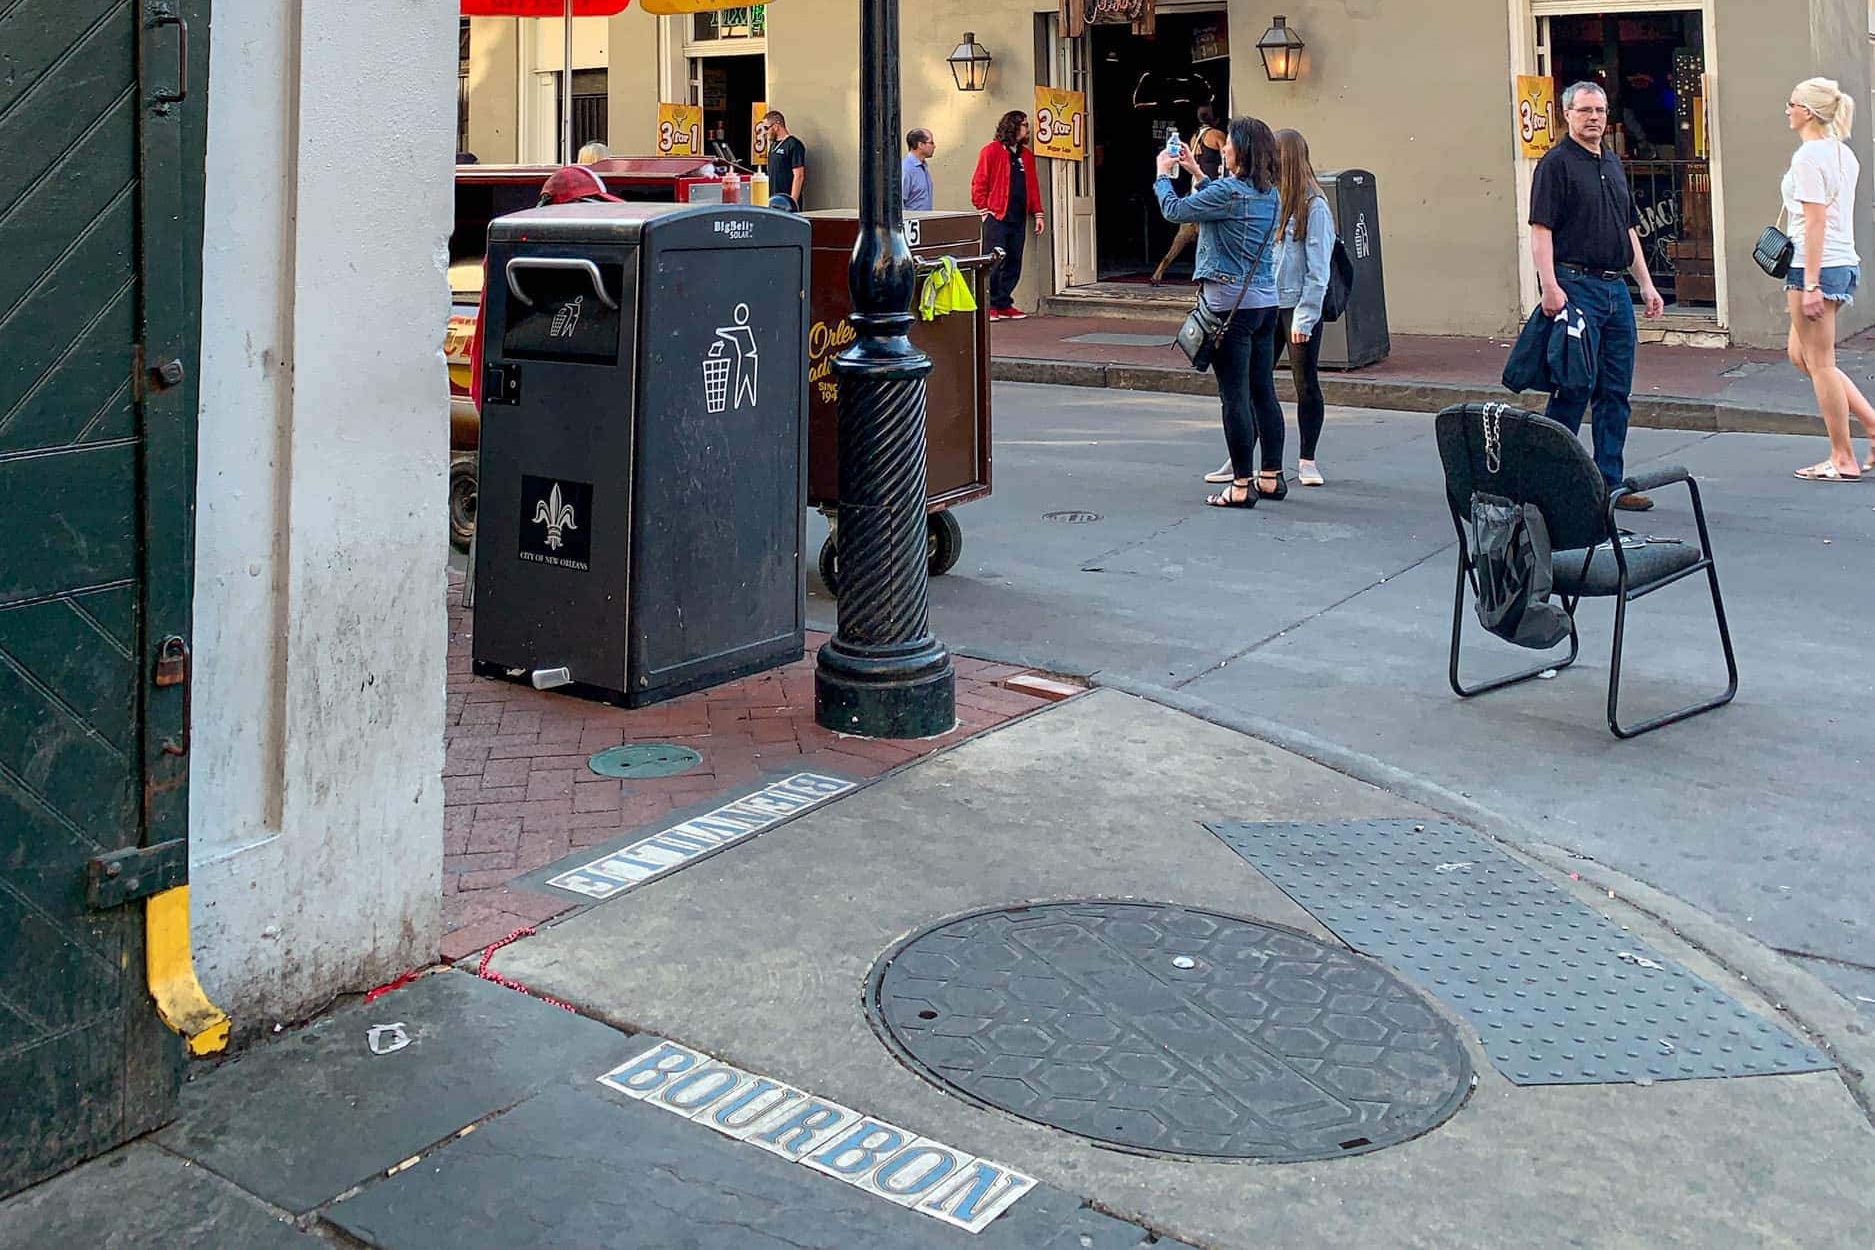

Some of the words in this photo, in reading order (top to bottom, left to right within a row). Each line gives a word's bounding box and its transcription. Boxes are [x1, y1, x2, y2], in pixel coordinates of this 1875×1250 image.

[659, 121, 674, 152] 3
[673, 131, 689, 145] for
[690, 123, 699, 154] 1
[1036, 108, 1053, 144] 3
[1053, 120, 1072, 136] for
[1072, 112, 1082, 148] 1
[1520, 99, 1534, 143] 3
[1545, 100, 1555, 143] 1
[519, 551, 534, 561] CITY
[553, 774, 850, 895] BIENVILLE
[608, 1046, 1027, 1225] BOURBON
